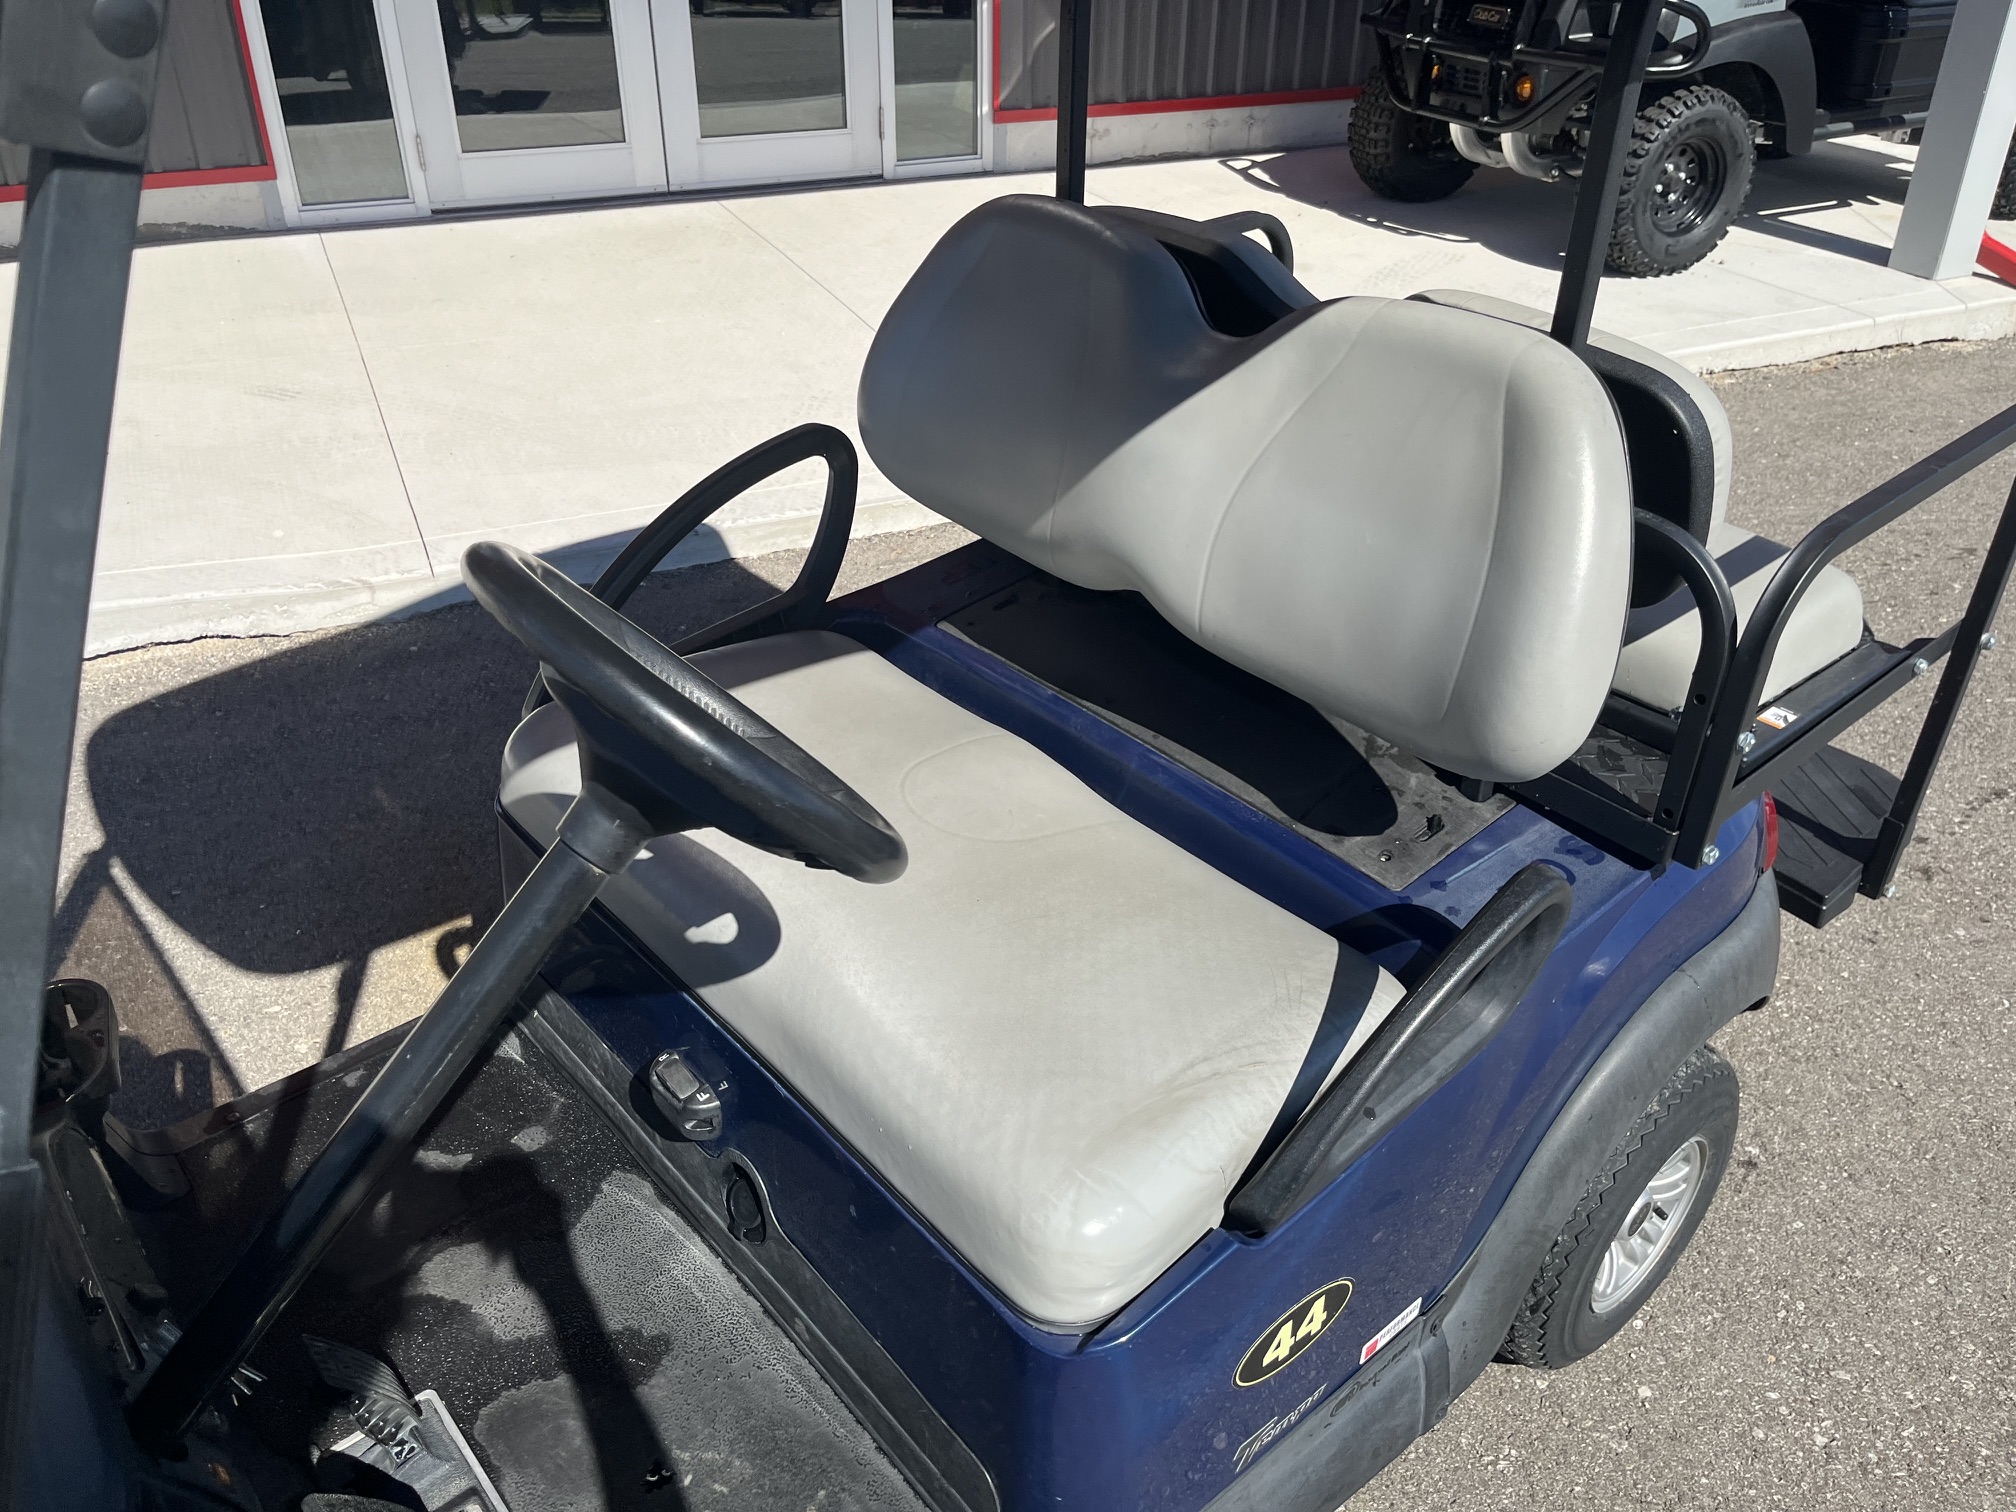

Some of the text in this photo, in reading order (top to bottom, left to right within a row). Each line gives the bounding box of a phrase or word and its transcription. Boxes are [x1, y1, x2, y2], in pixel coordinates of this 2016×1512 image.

[658, 1053, 669, 1062] R
[718, 1080, 729, 1091] F
[696, 1092, 711, 1102] F
[1379, 1303, 1419, 1342] PERFORMANCE
[1262, 1294, 1328, 1368] 44
